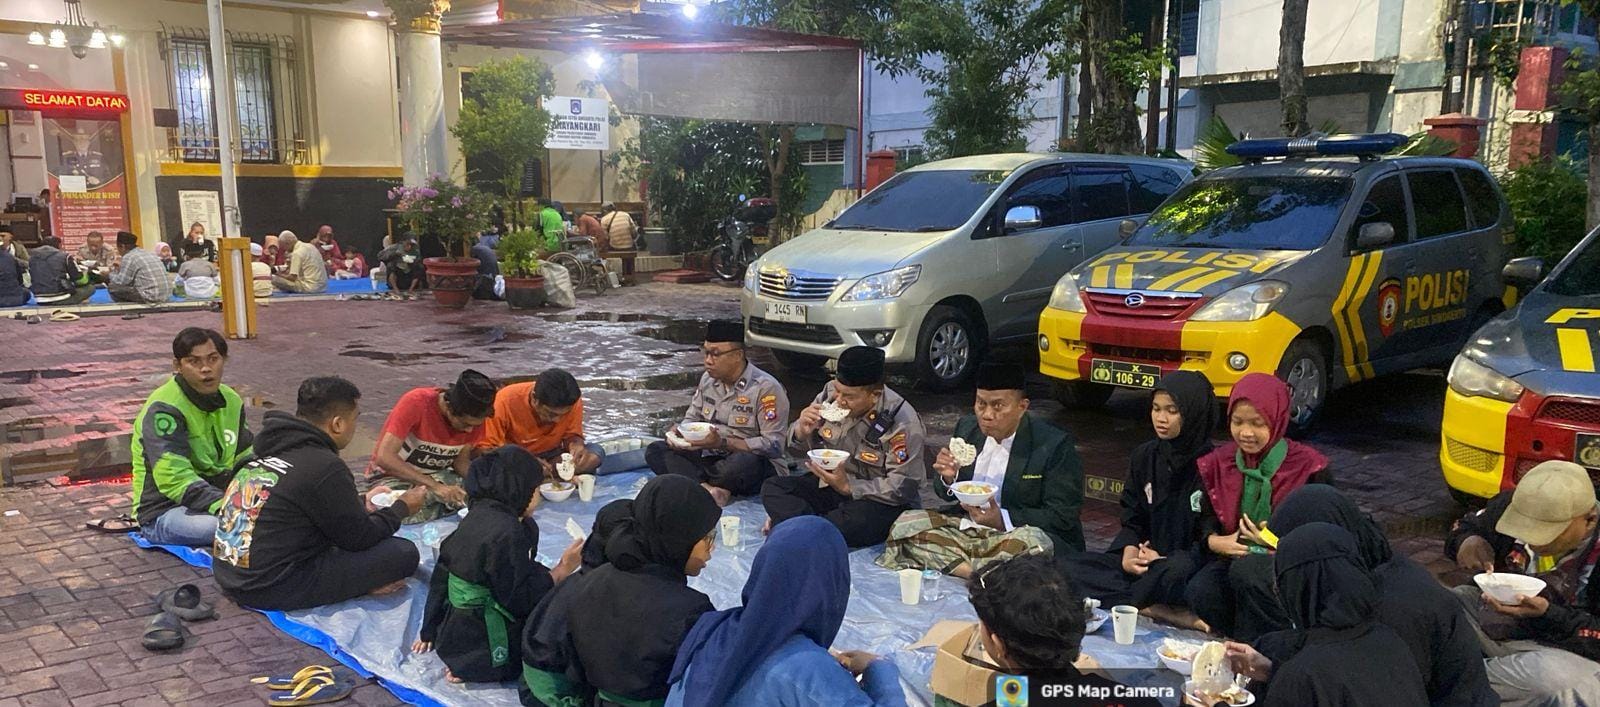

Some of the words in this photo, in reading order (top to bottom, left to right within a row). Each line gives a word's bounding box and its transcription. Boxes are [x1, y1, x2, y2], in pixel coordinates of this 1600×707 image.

[24, 93, 83, 106] SELAMAT
[1088, 251, 1279, 274] POLISI
[1405, 269, 1469, 313] POLISI
[774, 303, 790, 315] 1445
[1115, 371, 1134, 385] 106
[1141, 374, 1155, 387] 29
[732, 405, 753, 413] POLRI
[418, 444, 446, 454] ONLY
